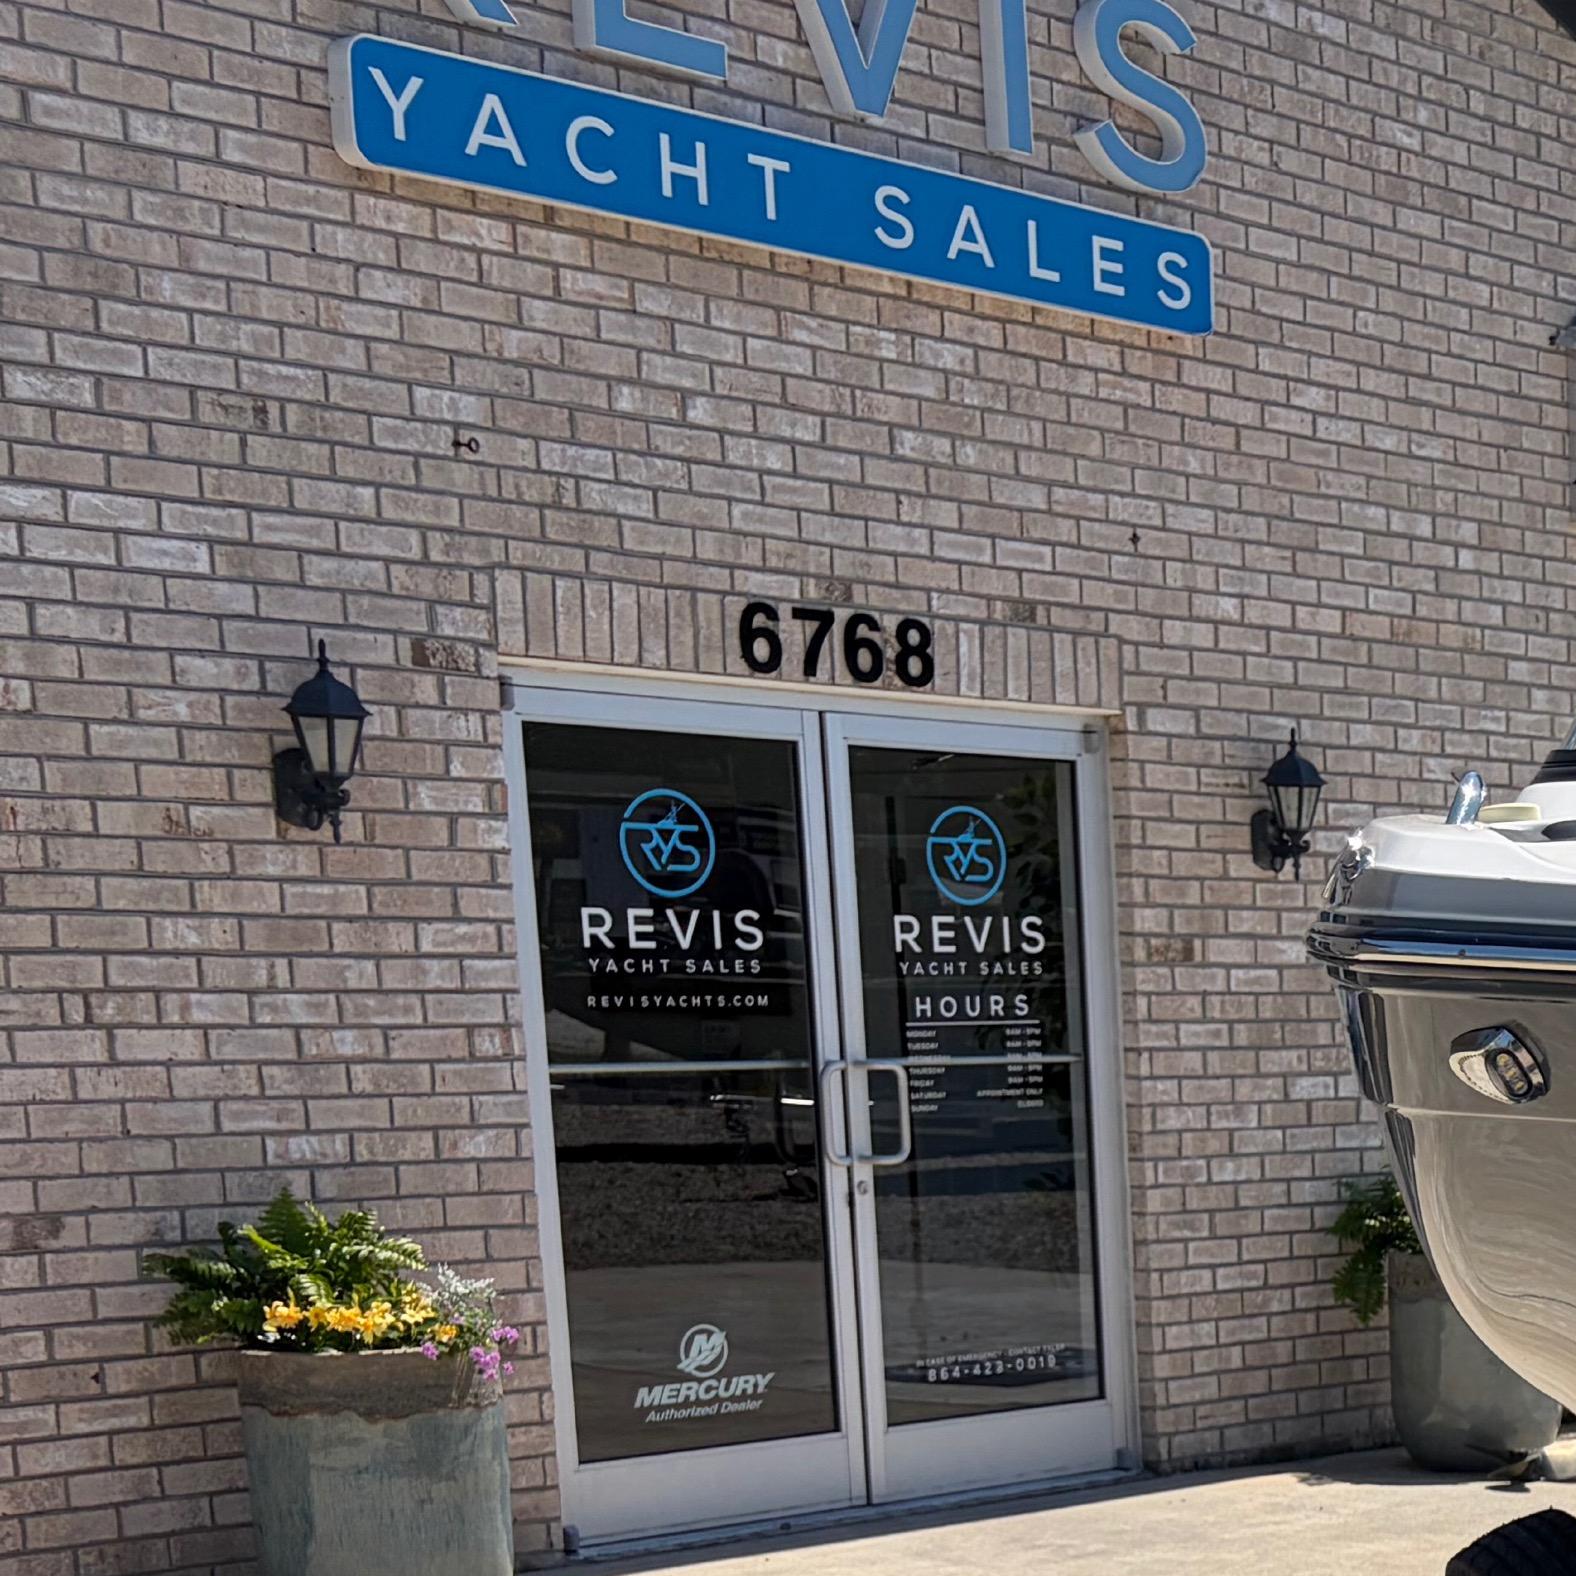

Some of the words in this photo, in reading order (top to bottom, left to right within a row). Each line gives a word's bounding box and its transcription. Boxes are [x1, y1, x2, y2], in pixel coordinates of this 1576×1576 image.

[442, 0, 1206, 192] VIS
[368, 67, 790, 220] YACHT
[874, 186, 1191, 311] SALES
[739, 602, 935, 687] 6768
[581, 907, 764, 951] REVIS
[893, 914, 1046, 954] REVIS
[589, 957, 670, 974] YACHT
[685, 959, 761, 974] SALES
[899, 961, 968, 975] YACHT
[979, 961, 1043, 975] SALES
[587, 995, 769, 1008] REVISYACHTS.COM
[915, 994, 1029, 1018] HOURS
[634, 1372, 775, 1408] MERCURY
[645, 1403, 719, 1423] Authorized
[720, 1399, 763, 1414] Dealer
